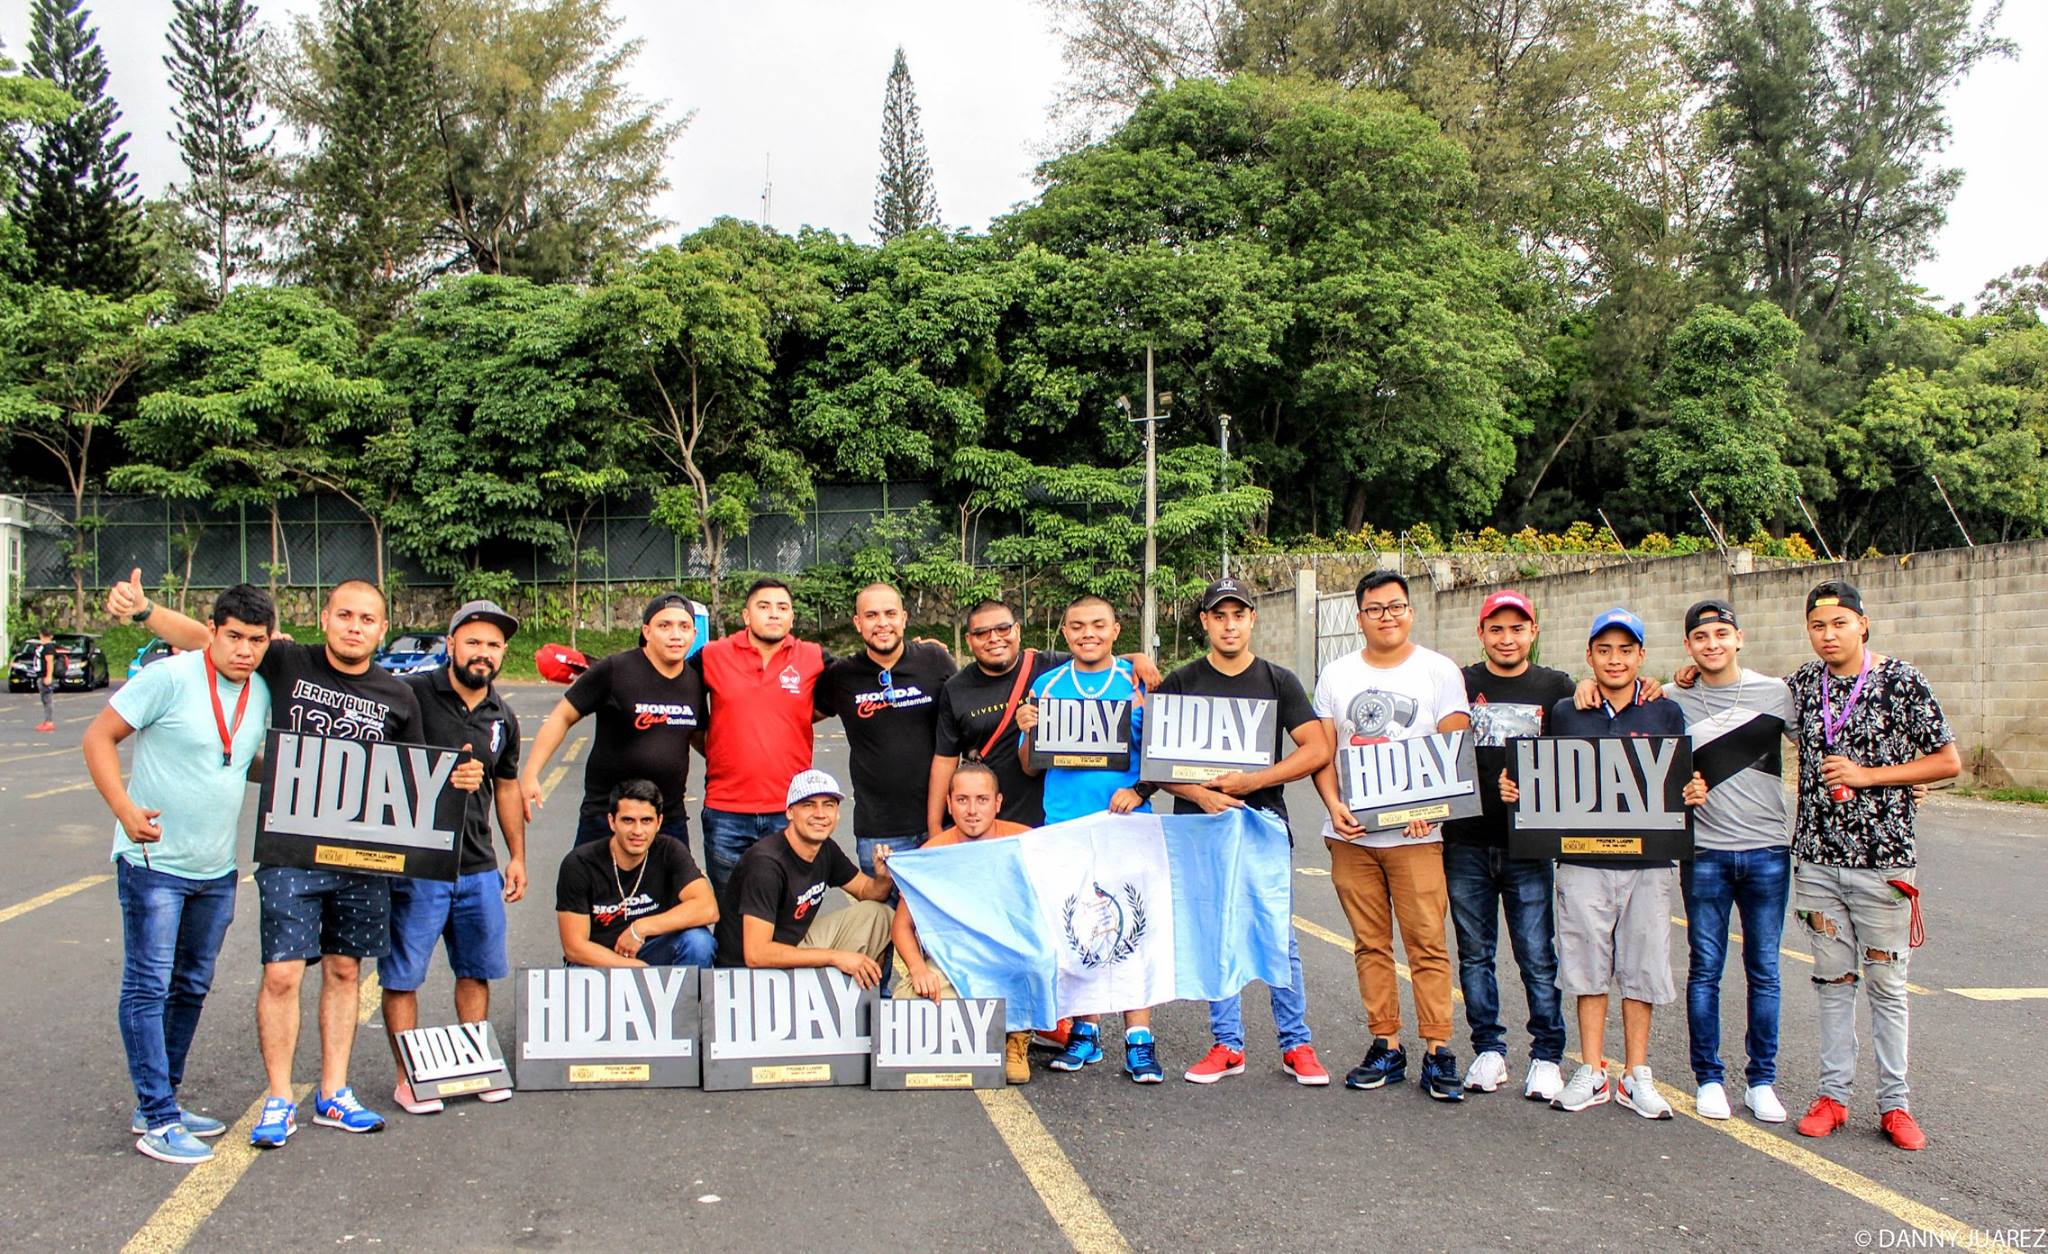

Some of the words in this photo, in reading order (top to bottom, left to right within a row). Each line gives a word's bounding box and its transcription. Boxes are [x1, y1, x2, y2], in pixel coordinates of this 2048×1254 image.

[292, 679, 346, 709] JERRY
[343, 694, 389, 721] BUILT
[634, 703, 694, 716] HONDA
[1038, 698, 1126, 746] HDAY
[1152, 693, 1270, 755] HDAY
[272, 733, 459, 834] HDAY
[1348, 730, 1465, 802] HDAY
[1517, 738, 1678, 816] HDAY
[528, 968, 687, 1046] HDAY
[713, 967, 862, 1046] HDAY
[880, 999, 998, 1057] HDAY
[405, 1021, 495, 1075] HDAY
